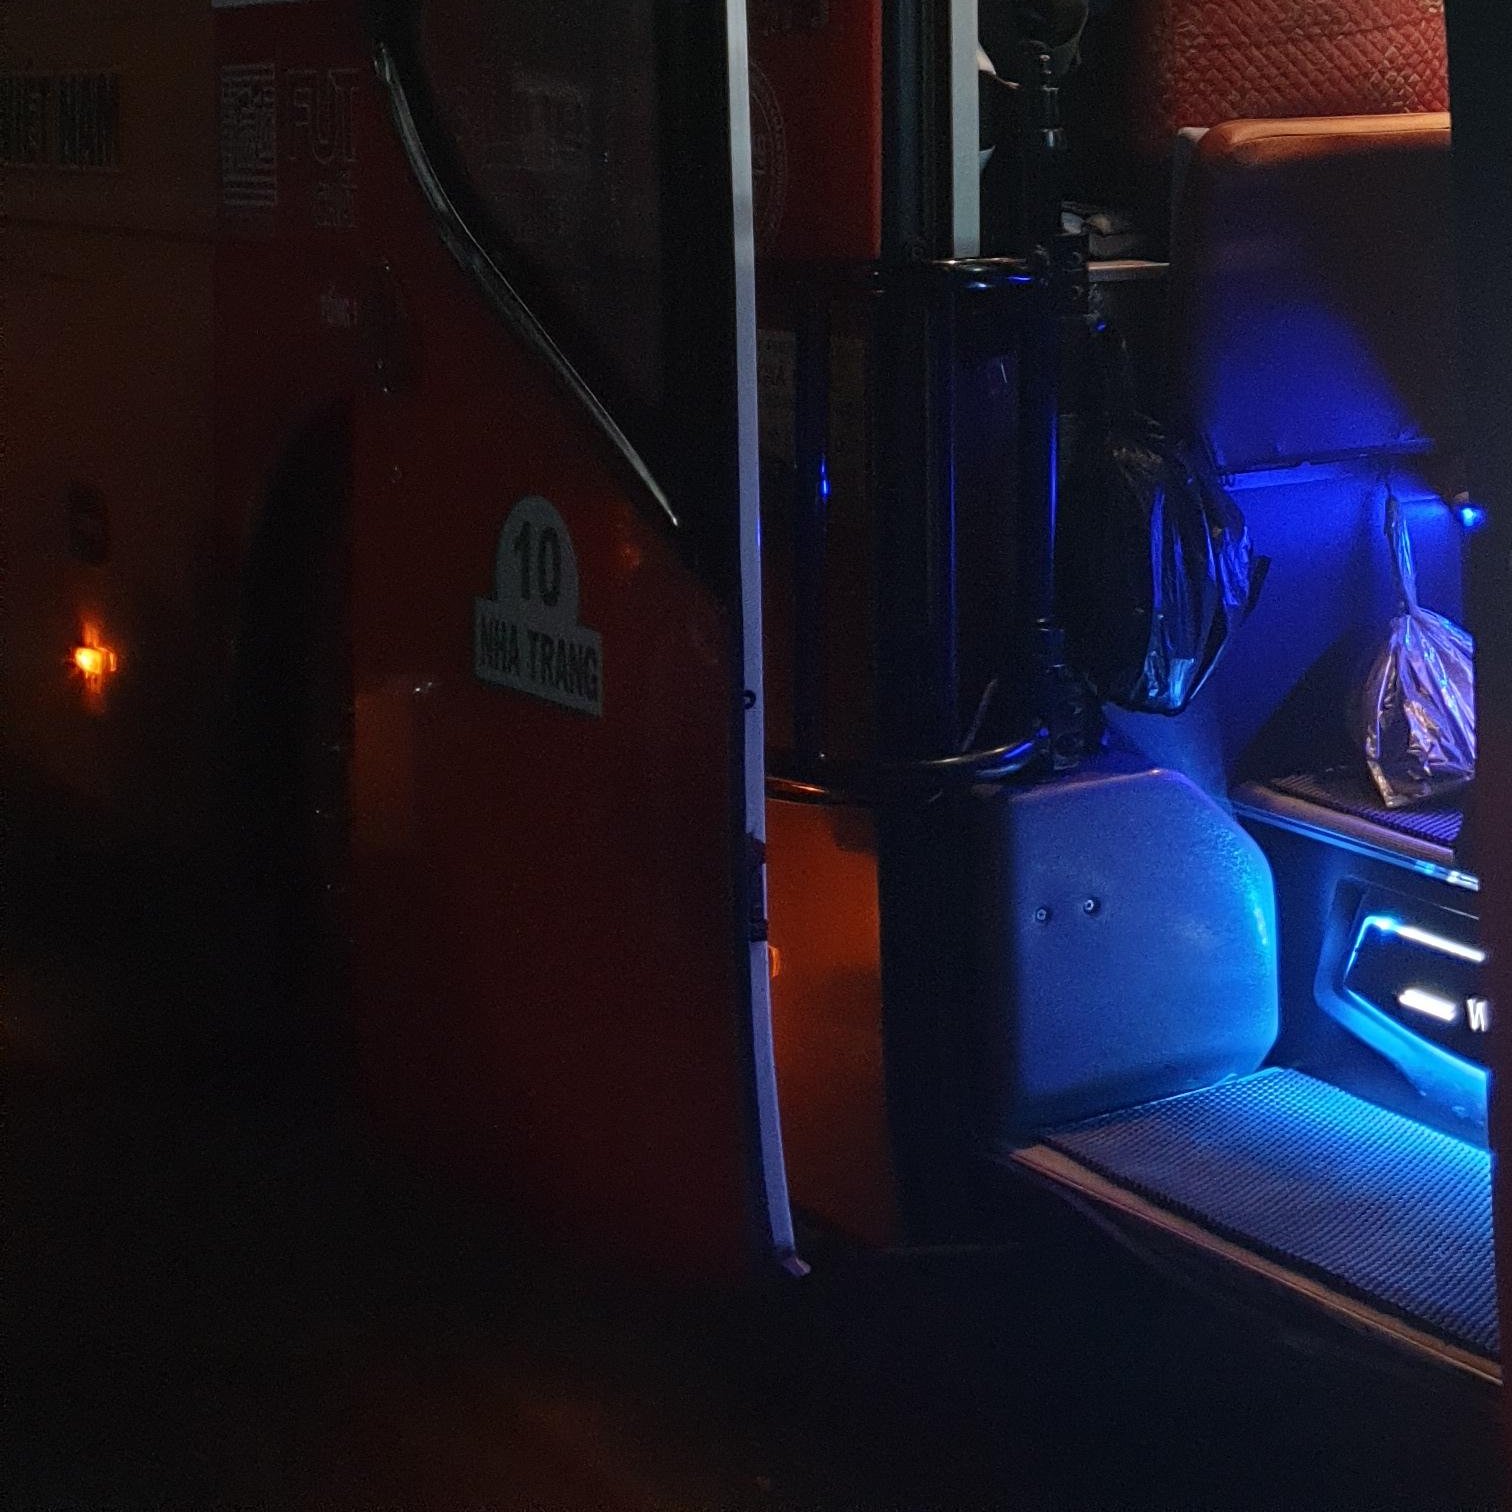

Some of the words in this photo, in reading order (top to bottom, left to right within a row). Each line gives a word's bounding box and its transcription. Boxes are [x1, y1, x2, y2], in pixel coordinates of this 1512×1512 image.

[285, 67, 361, 165] FUT
[514, 520, 562, 607] 10
[479, 612, 520, 676] NHA
[527, 628, 599, 702] TRANG
